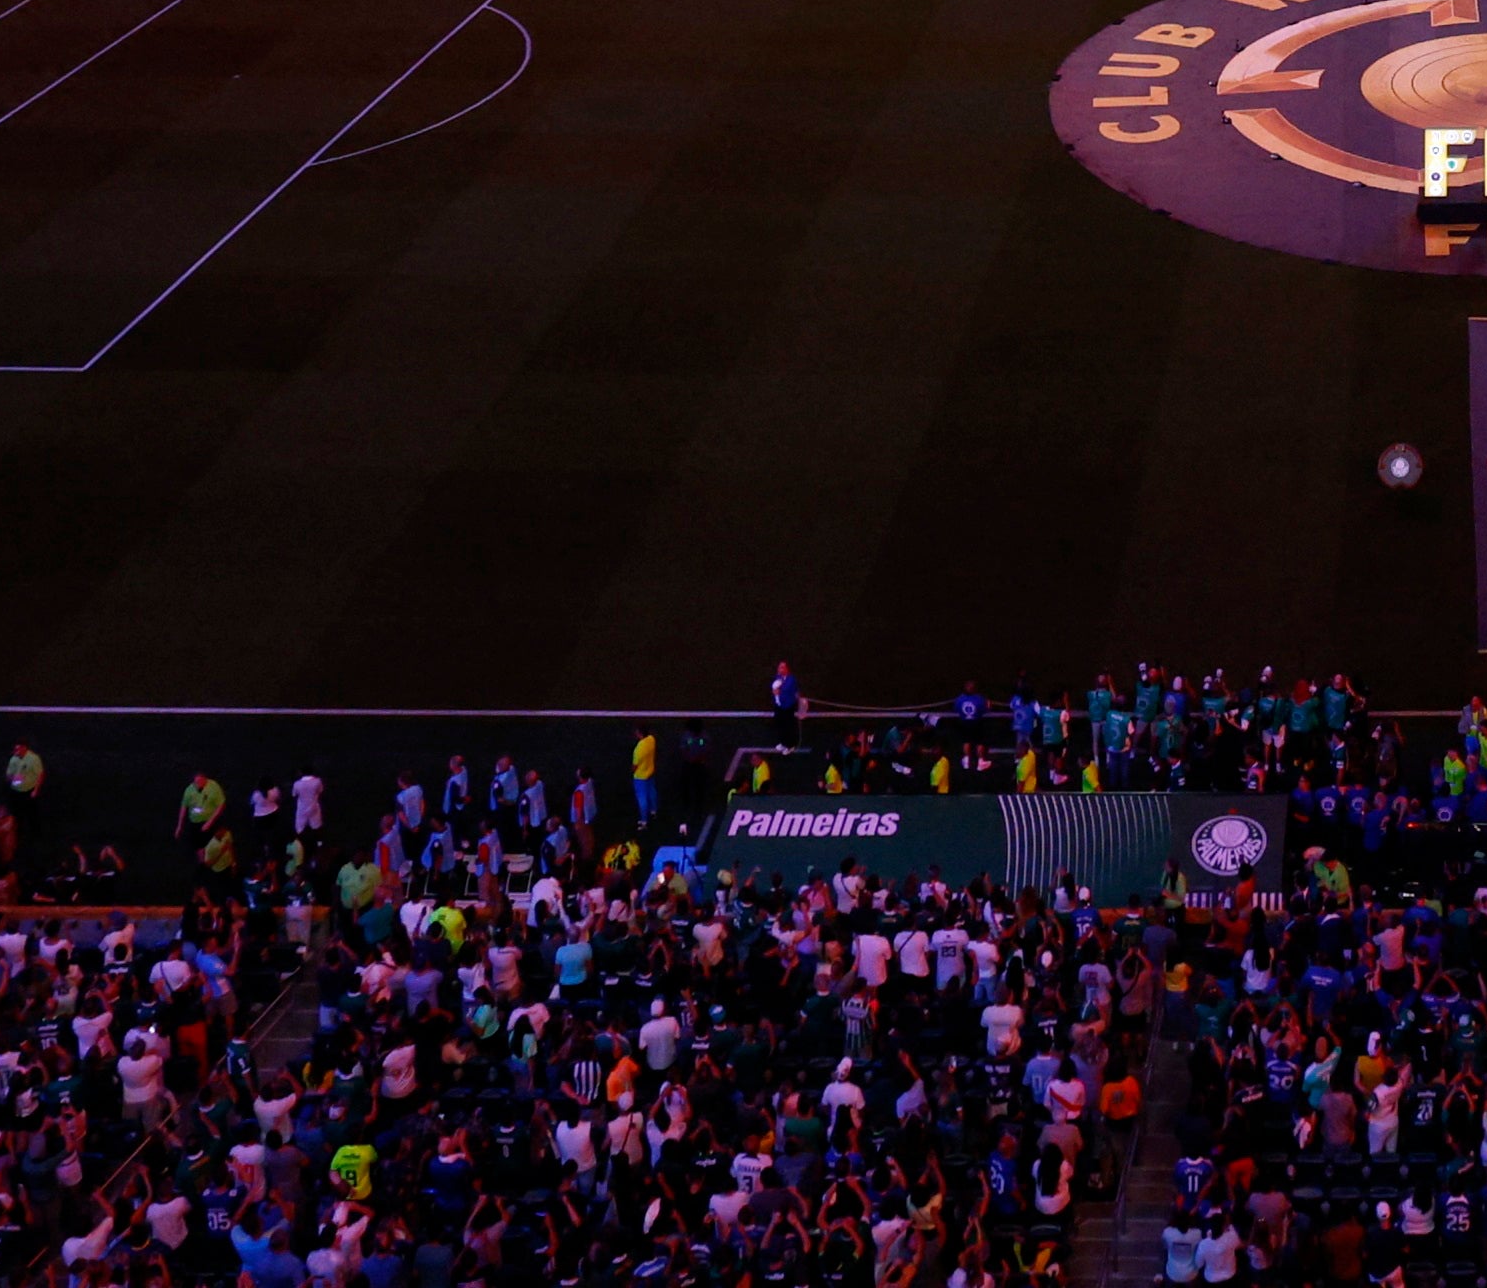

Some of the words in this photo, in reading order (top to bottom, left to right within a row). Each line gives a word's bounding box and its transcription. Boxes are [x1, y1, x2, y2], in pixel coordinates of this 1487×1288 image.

[1097, 23, 1216, 145] CLUB
[727, 807, 901, 838] Palmeiras
[1445, 1212, 1471, 1232] 25
